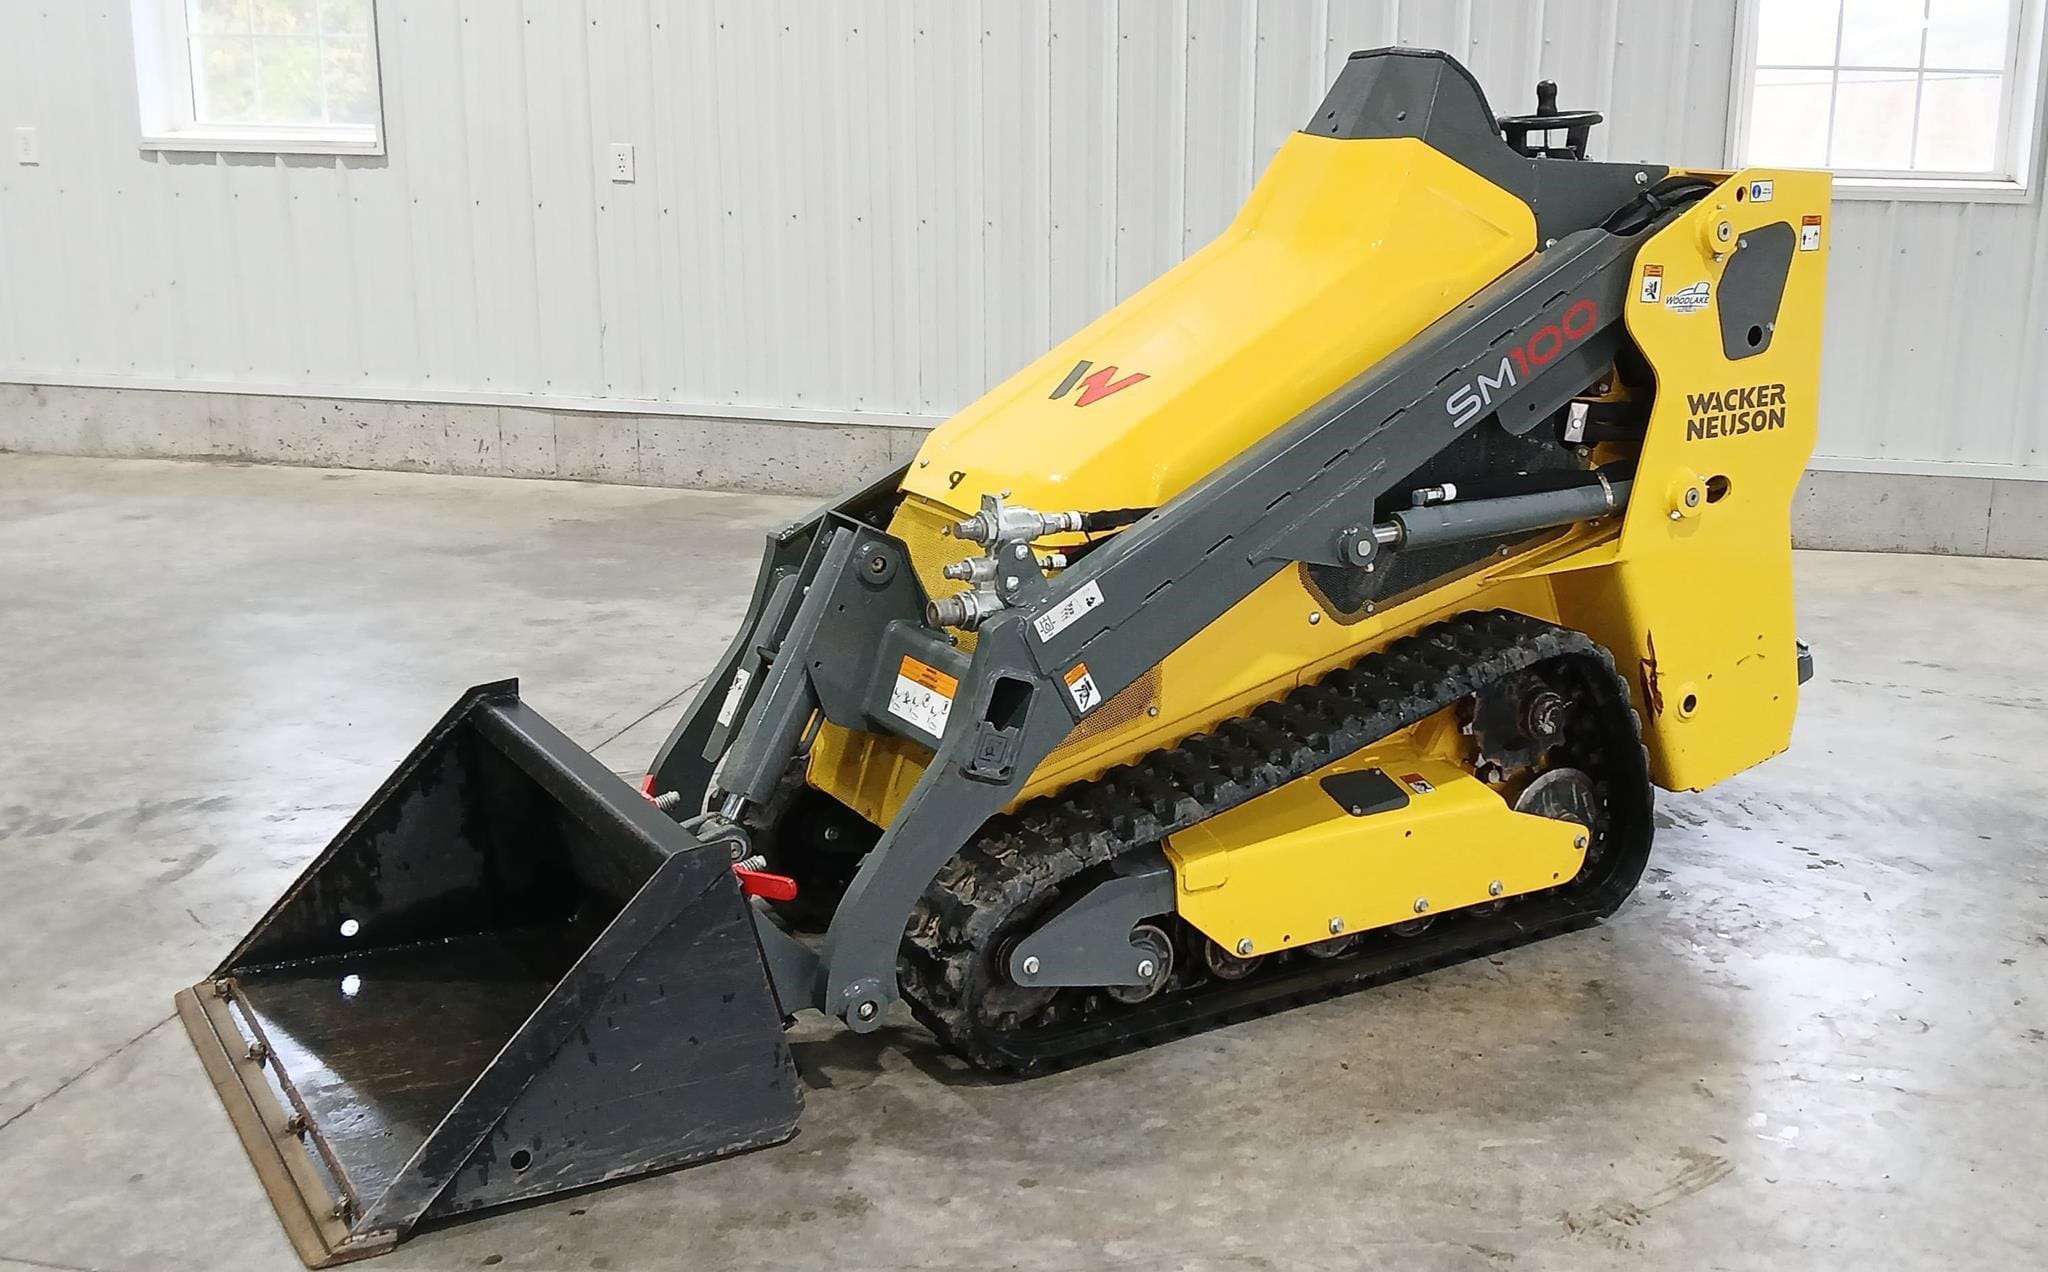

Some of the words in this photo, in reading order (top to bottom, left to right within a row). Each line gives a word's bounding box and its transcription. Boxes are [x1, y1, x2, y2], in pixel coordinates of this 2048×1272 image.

[1666, 296, 1709, 304] WOODLAKE
[1445, 299, 1598, 429] SM100
[1686, 383, 1786, 416] WACKER
[1686, 407, 1786, 442] NEUSON
